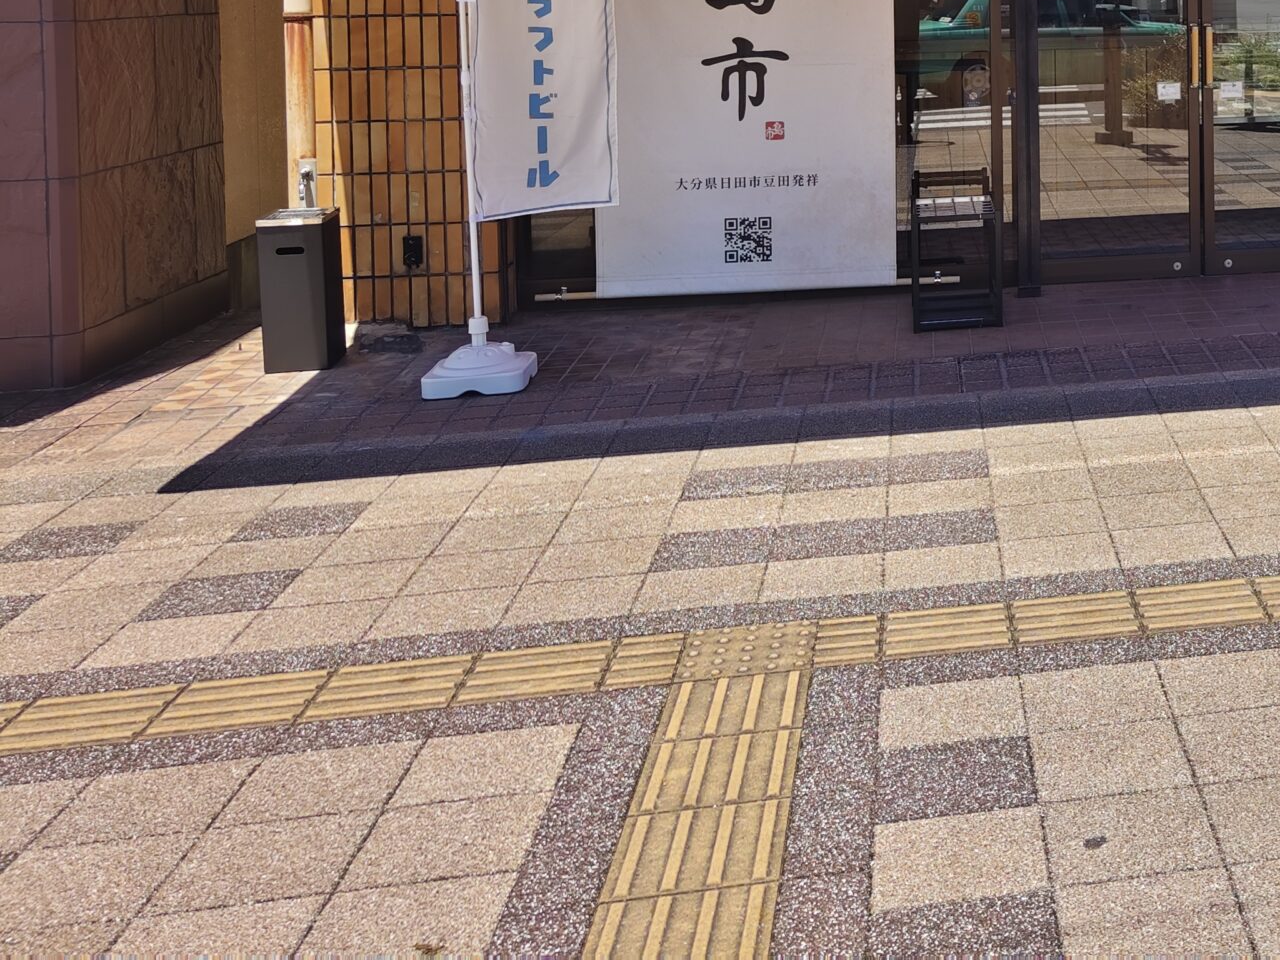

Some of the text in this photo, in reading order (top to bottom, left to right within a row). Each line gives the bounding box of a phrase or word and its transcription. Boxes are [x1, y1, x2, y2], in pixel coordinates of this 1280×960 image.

[675, 173, 819, 191] 大分県日田市豆田発祥
